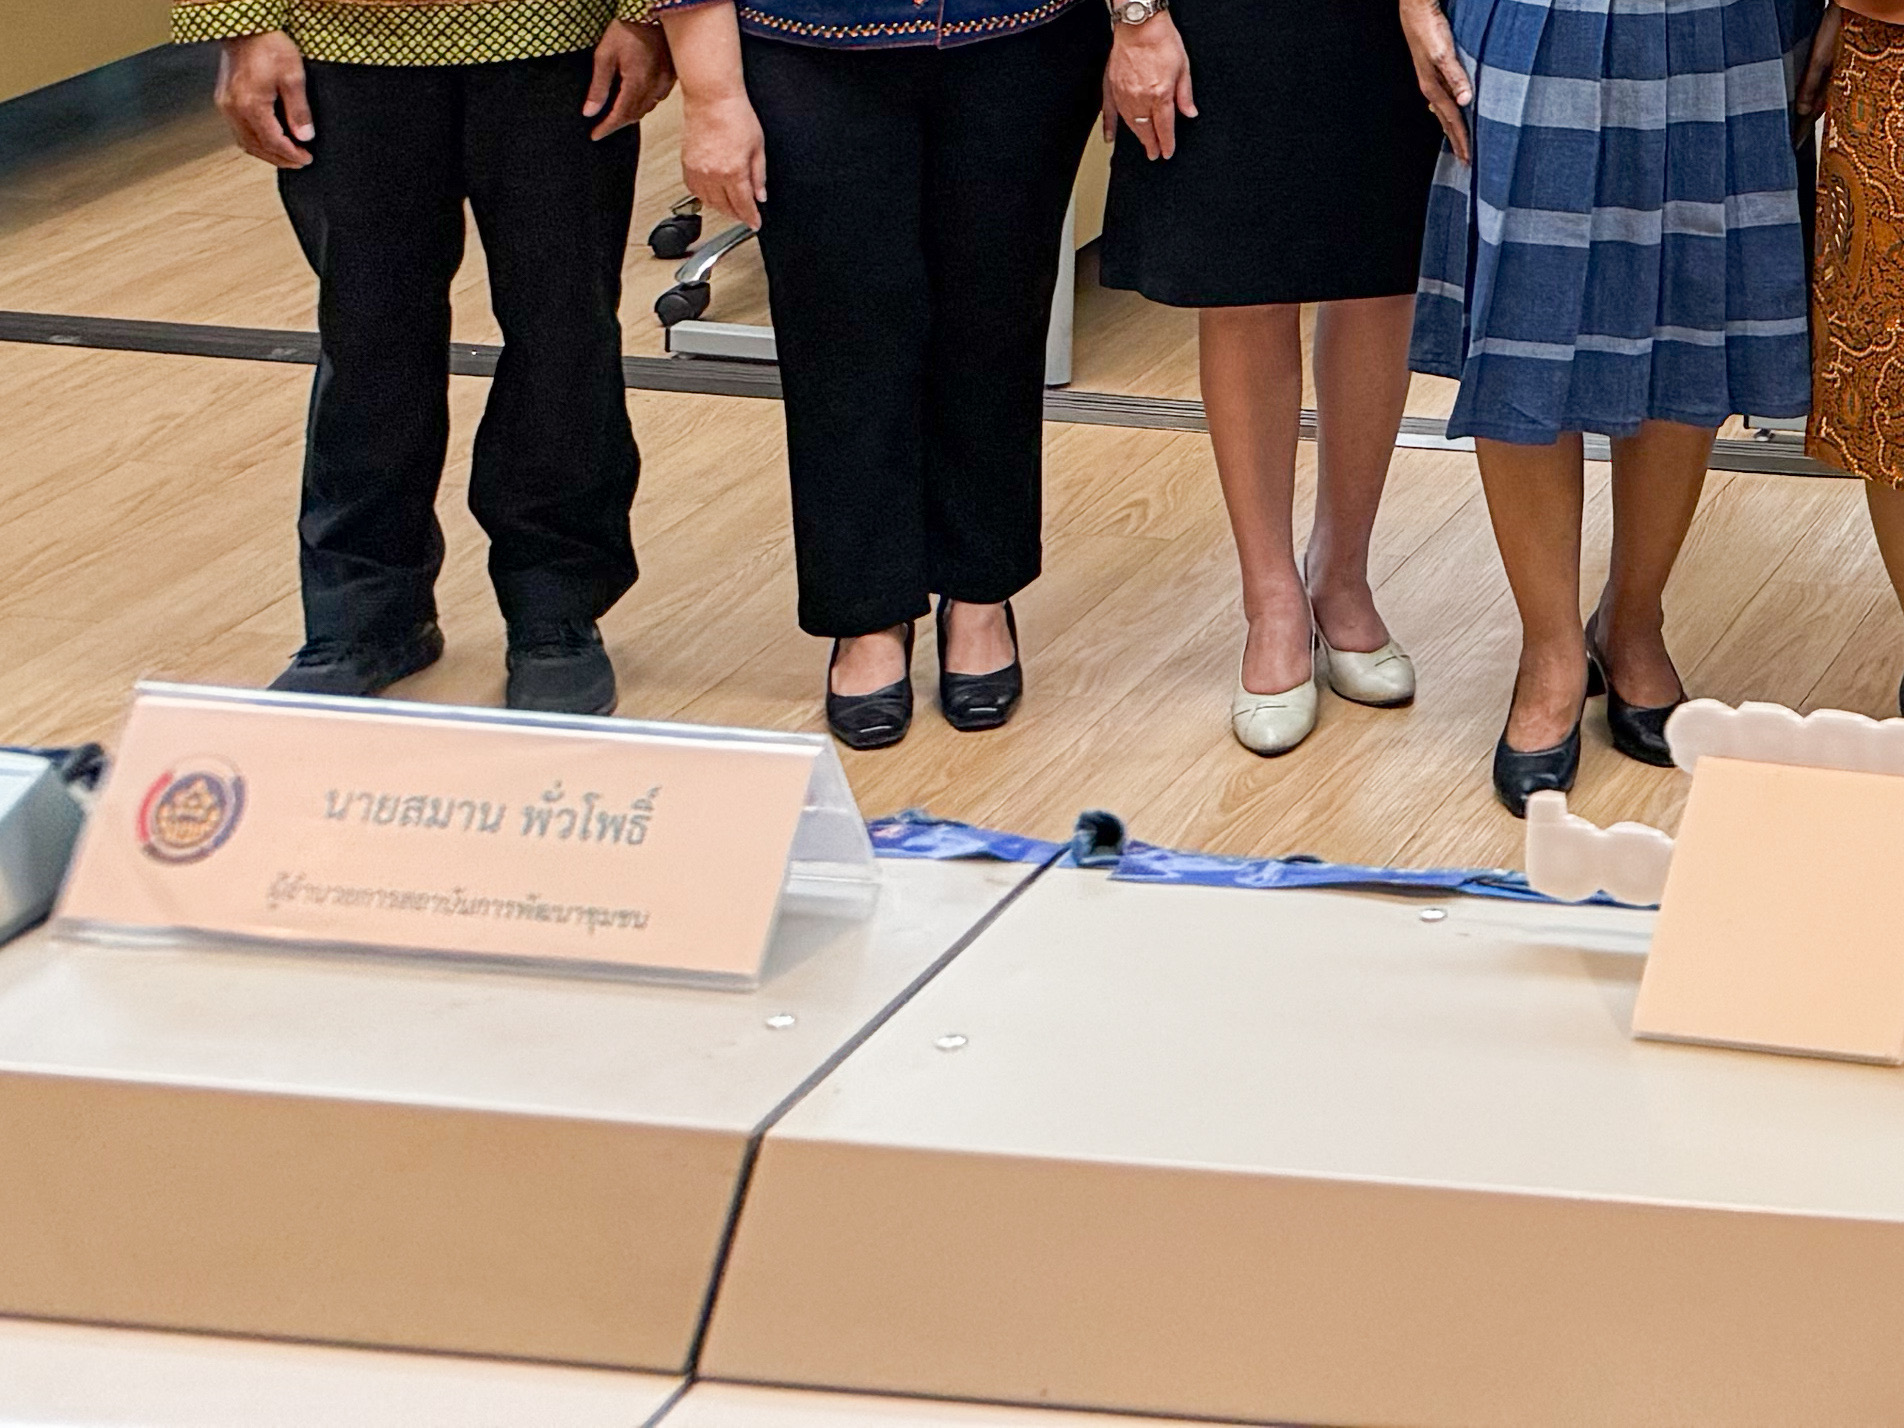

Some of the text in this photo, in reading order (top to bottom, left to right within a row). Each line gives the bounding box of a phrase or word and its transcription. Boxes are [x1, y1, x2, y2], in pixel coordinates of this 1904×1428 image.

[324, 780, 662, 846] นายสมาน พั่วโพธิ์
